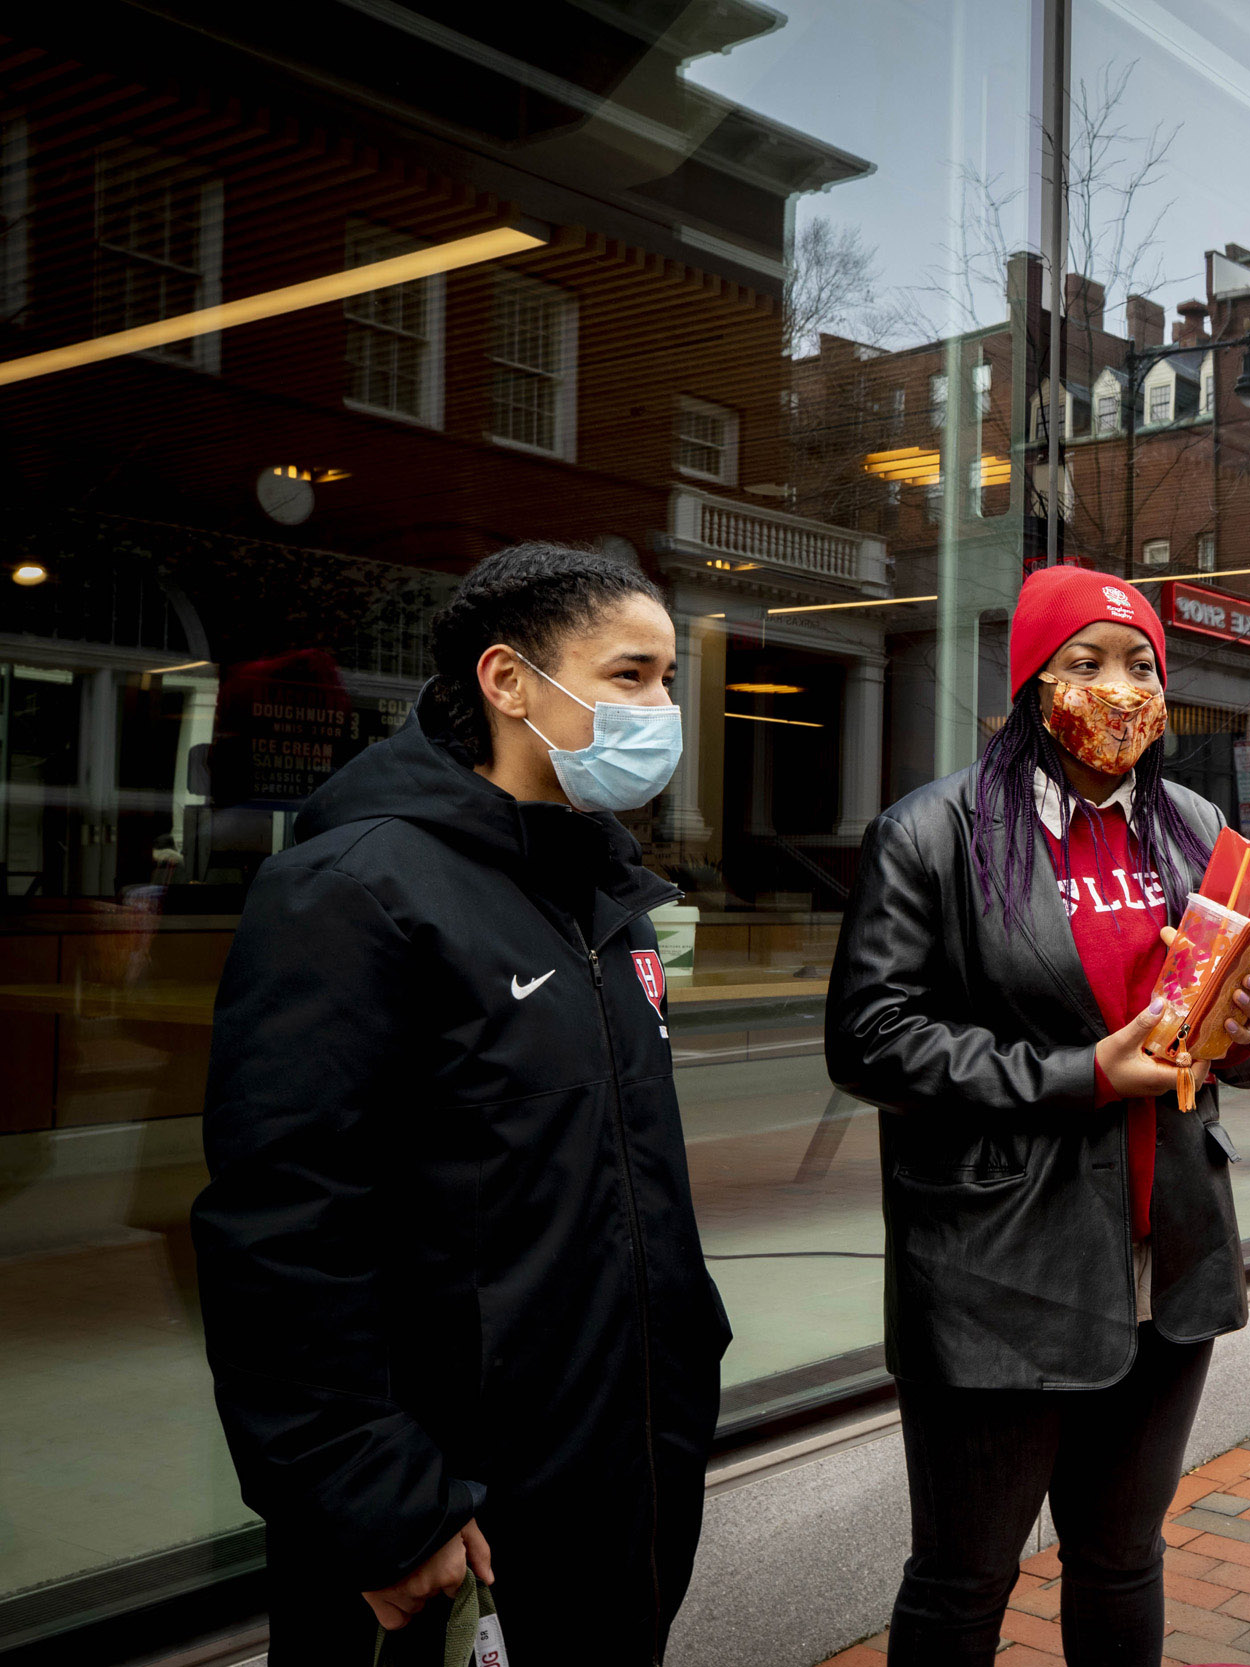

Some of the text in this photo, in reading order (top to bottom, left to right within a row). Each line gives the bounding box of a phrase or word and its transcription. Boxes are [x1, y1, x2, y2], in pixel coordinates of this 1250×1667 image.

[1106, 604, 1135, 615] England
[1111, 610, 1133, 620] Rugby
[252, 702, 345, 726] DOUGHNUTS
[252, 738, 333, 758] ICE CREAM
[252, 754, 332, 773] SANDWICH
